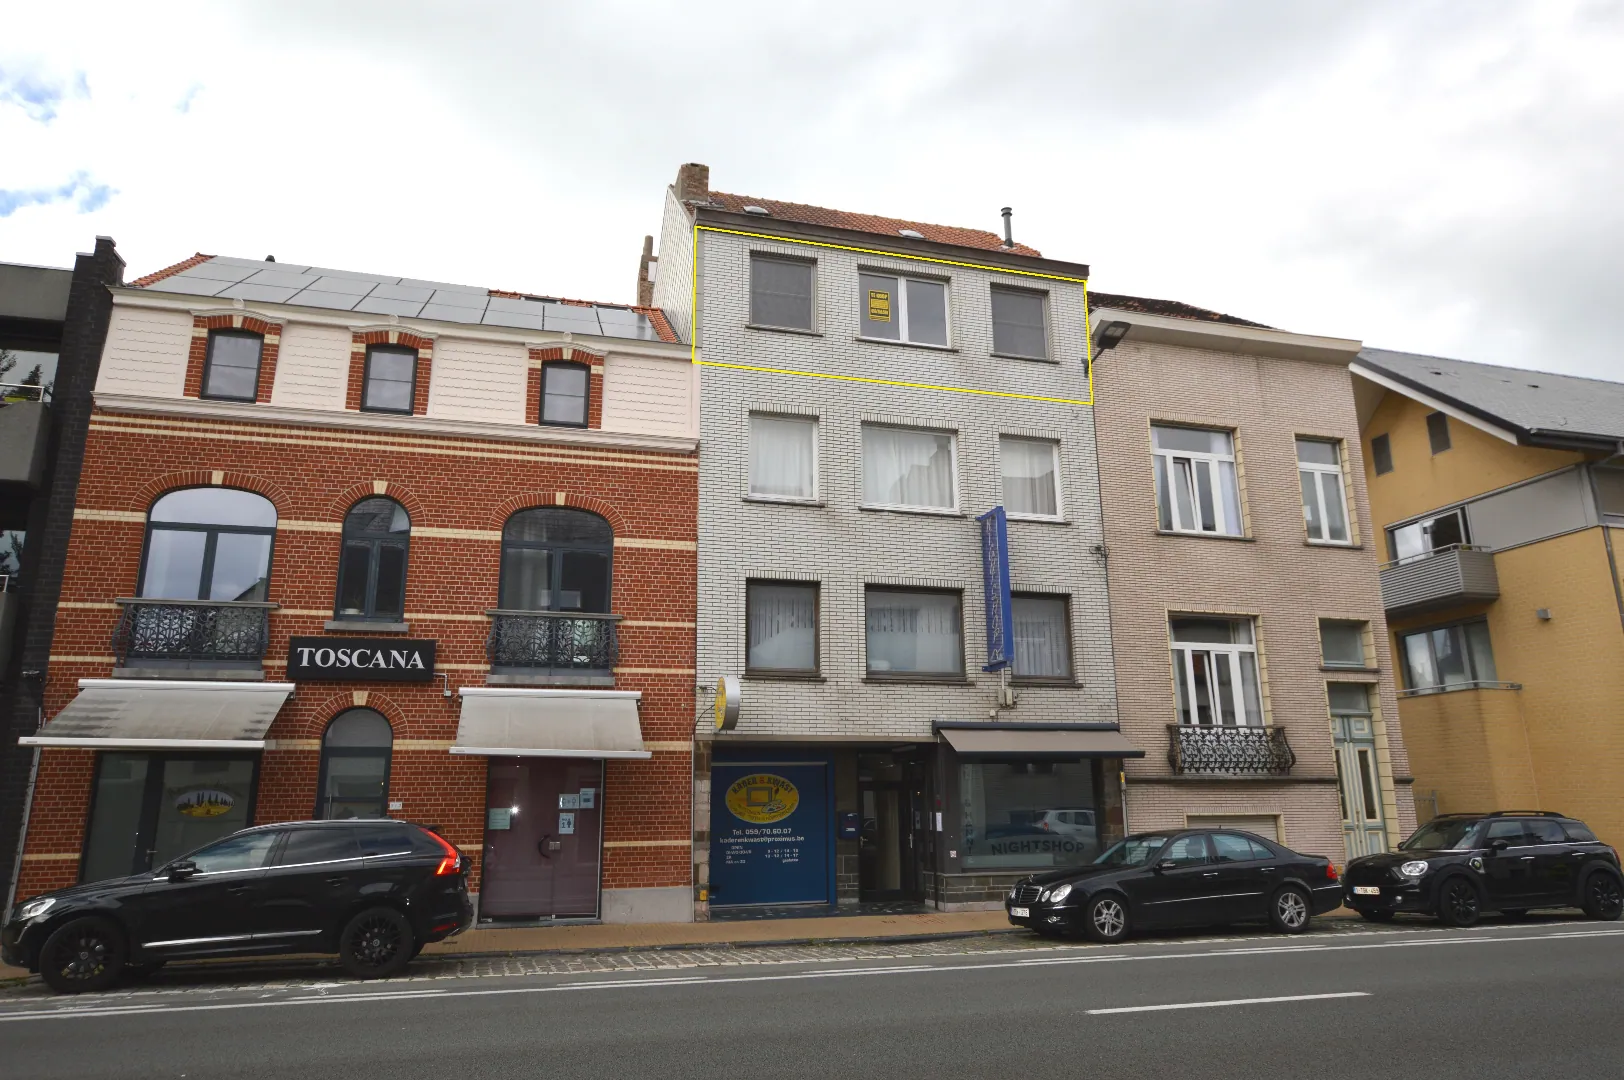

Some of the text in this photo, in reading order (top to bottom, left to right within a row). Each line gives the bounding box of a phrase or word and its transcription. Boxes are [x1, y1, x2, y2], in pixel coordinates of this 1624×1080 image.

[297, 647, 425, 670] TOSCANA
[732, 777, 758, 794] KADER
[768, 777, 793, 793] KWAST
[991, 840, 1085, 856] NIGHTSHOP
